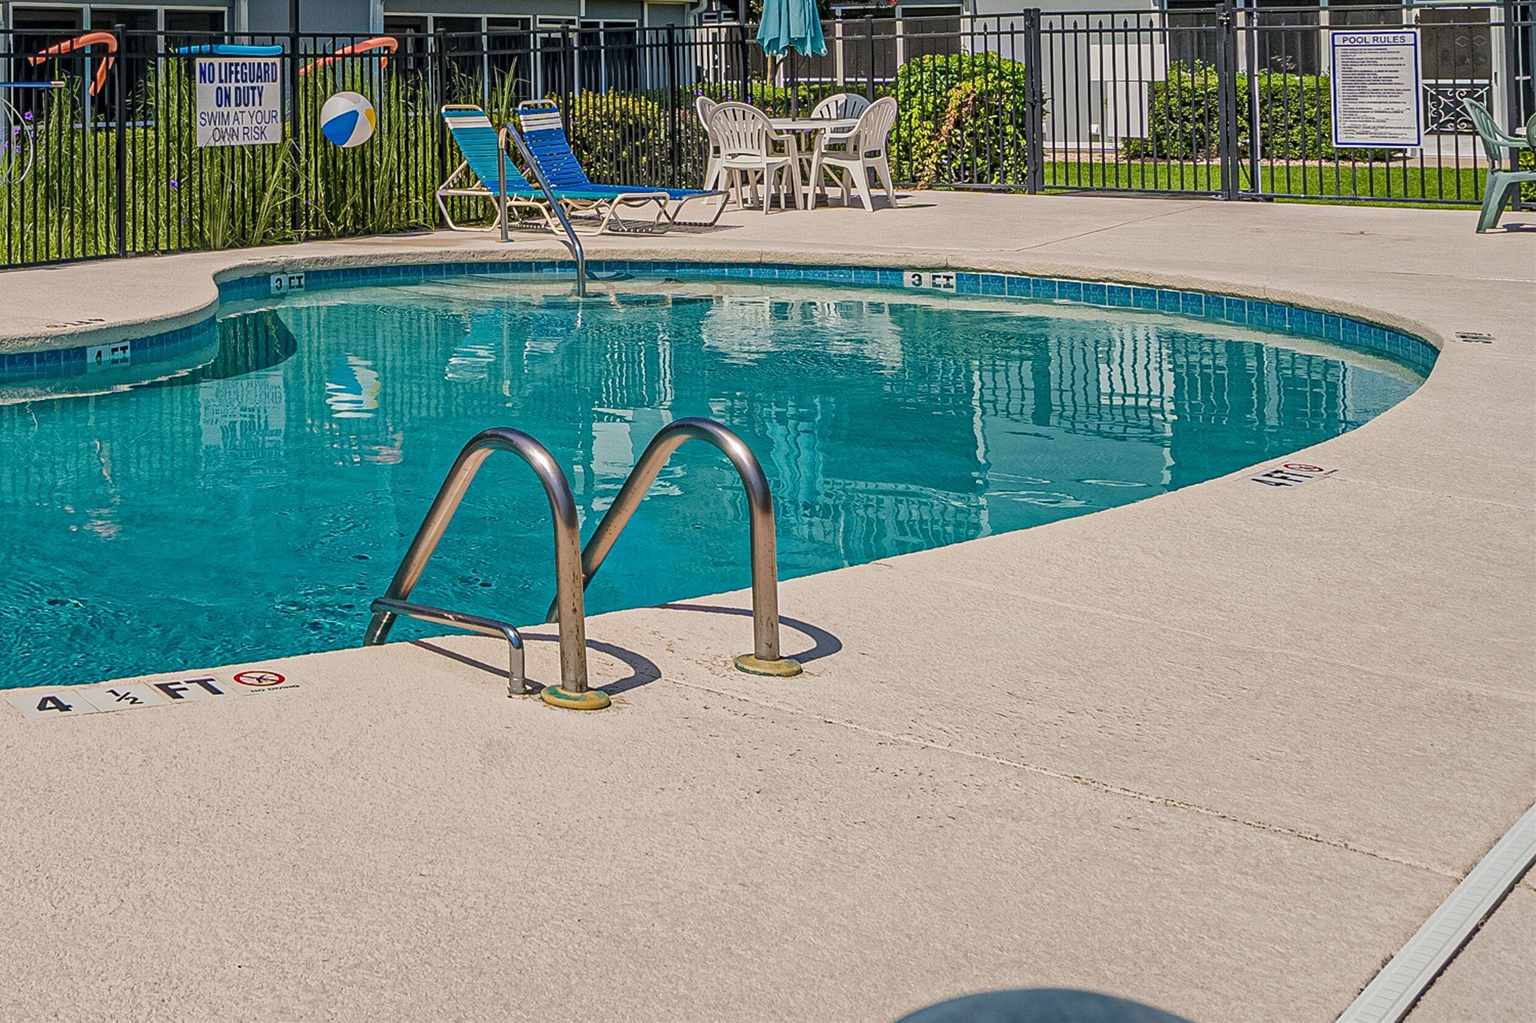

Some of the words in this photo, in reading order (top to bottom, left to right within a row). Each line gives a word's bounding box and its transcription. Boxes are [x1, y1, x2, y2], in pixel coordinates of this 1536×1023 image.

[1342, 36, 1370, 45] POOL
[1372, 35, 1406, 44] RULES
[198, 62, 216, 84] NO
[218, 61, 278, 84] LIFEGUARD
[215, 86, 232, 108] ON
[234, 85, 264, 108] DUTY
[199, 111, 231, 127] SWIM
[232, 110, 247, 126] AT
[247, 109, 279, 125] YOUR
[212, 127, 240, 143] OWN
[242, 126, 268, 141] RISK
[275, 277, 283, 290] 3
[911, 273, 923, 287] 3
[35, 694, 73, 713] 4
[153, 676, 225, 700] FT
